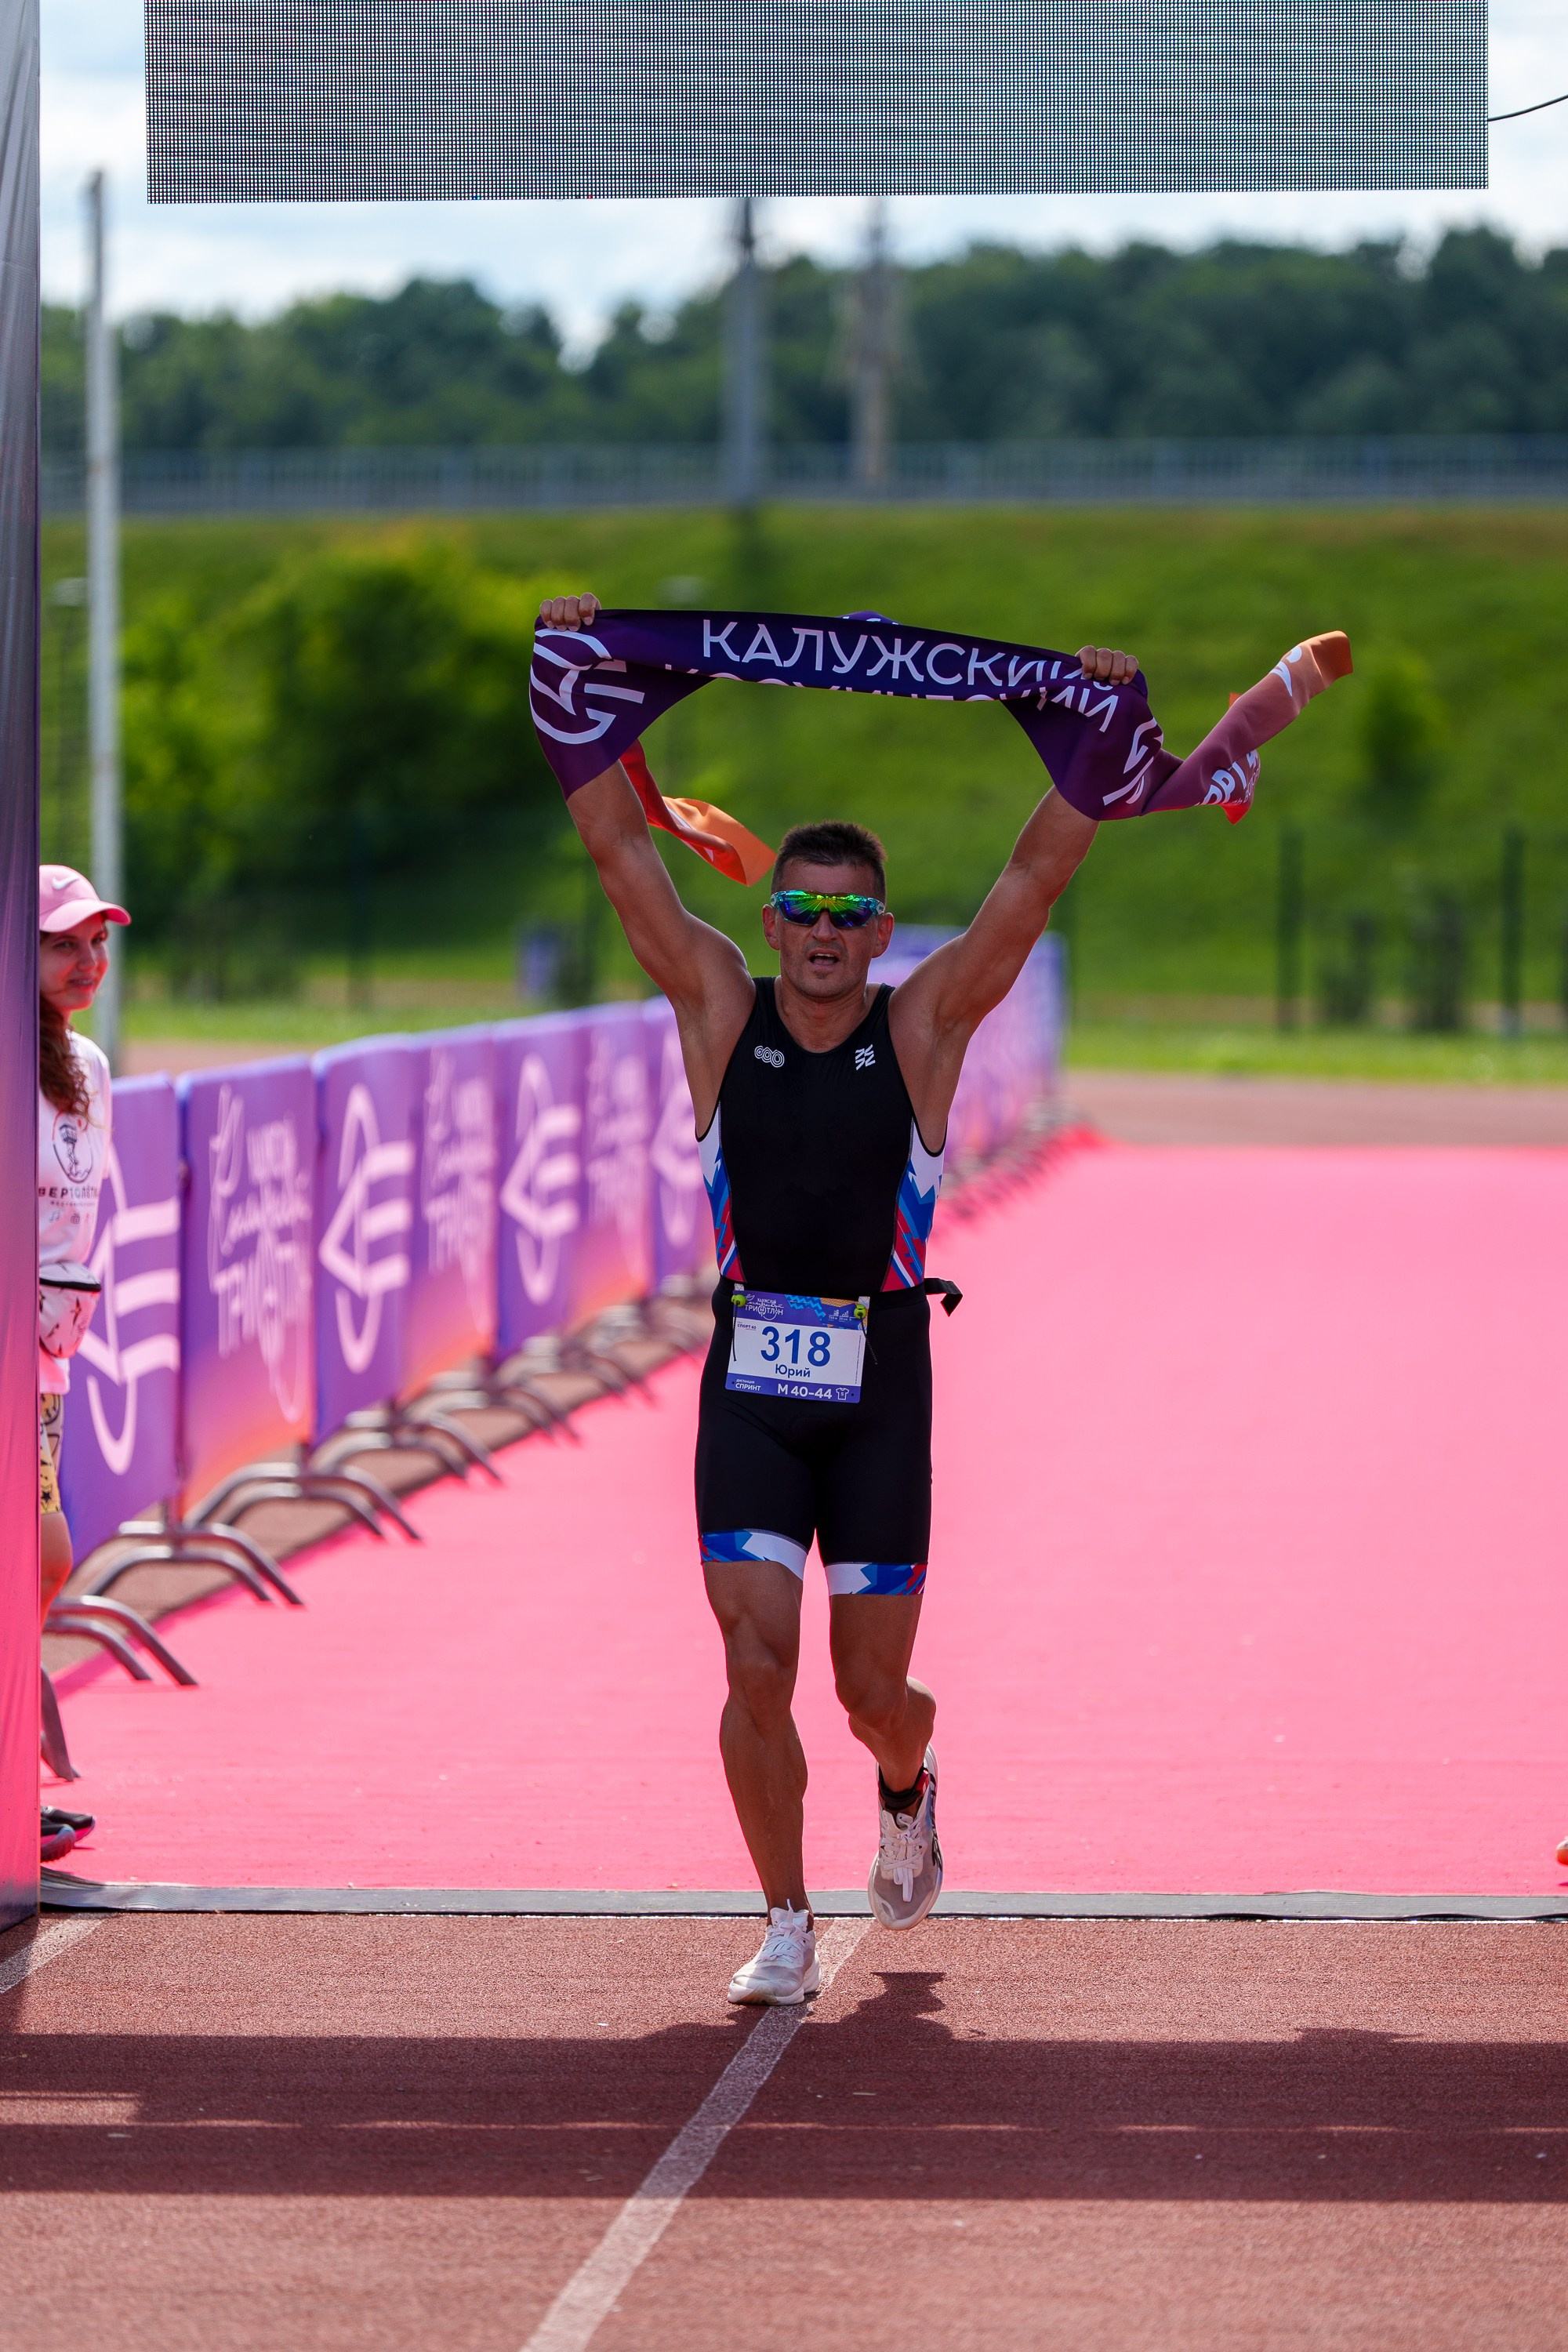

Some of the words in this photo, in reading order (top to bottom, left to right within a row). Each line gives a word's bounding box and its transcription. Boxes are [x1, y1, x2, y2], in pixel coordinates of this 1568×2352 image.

[760, 1326, 830, 1367] 318
[775, 1363, 811, 1378] Юрий
[791, 1385, 832, 1399] 40-44
